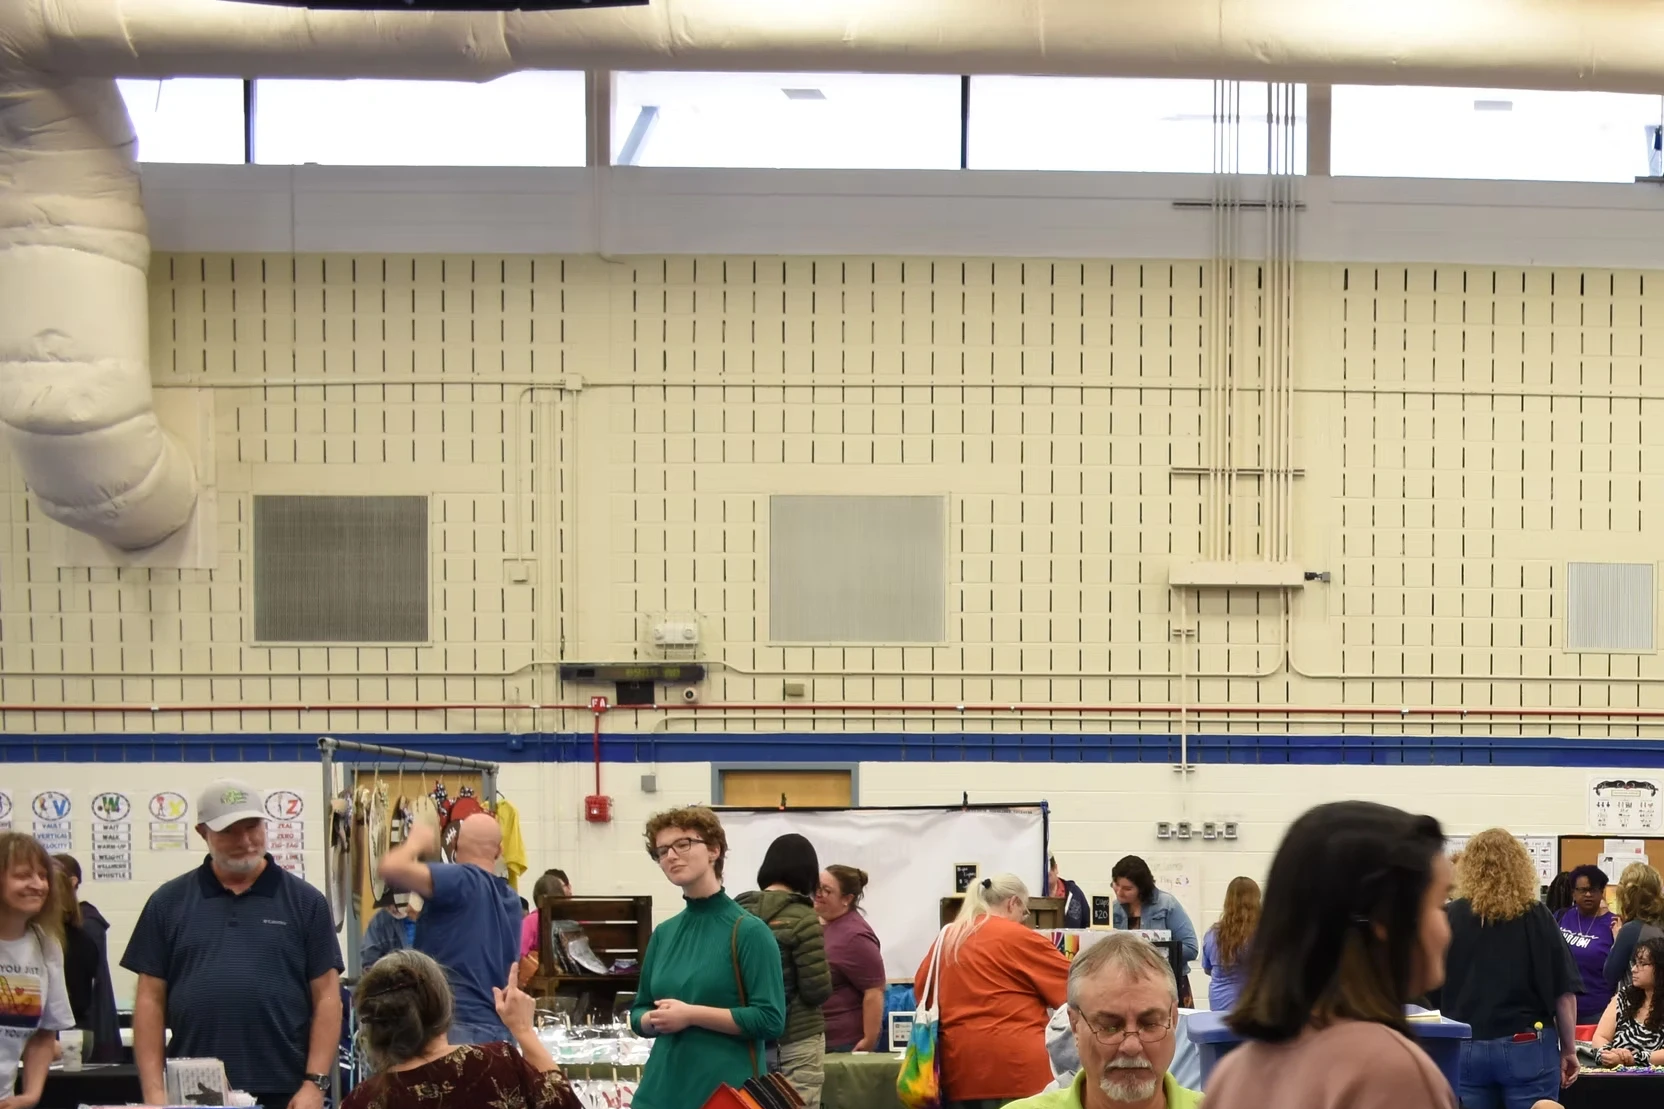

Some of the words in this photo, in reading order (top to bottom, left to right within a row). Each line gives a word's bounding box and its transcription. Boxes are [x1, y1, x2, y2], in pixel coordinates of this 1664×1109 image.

[52, 799, 66, 817] V
[102, 796, 121, 813] W
[169, 801, 184, 815] X
[286, 800, 298, 815] Z
[37, 832, 68, 840] VERTICAL
[1094, 910, 1109, 919] $20
